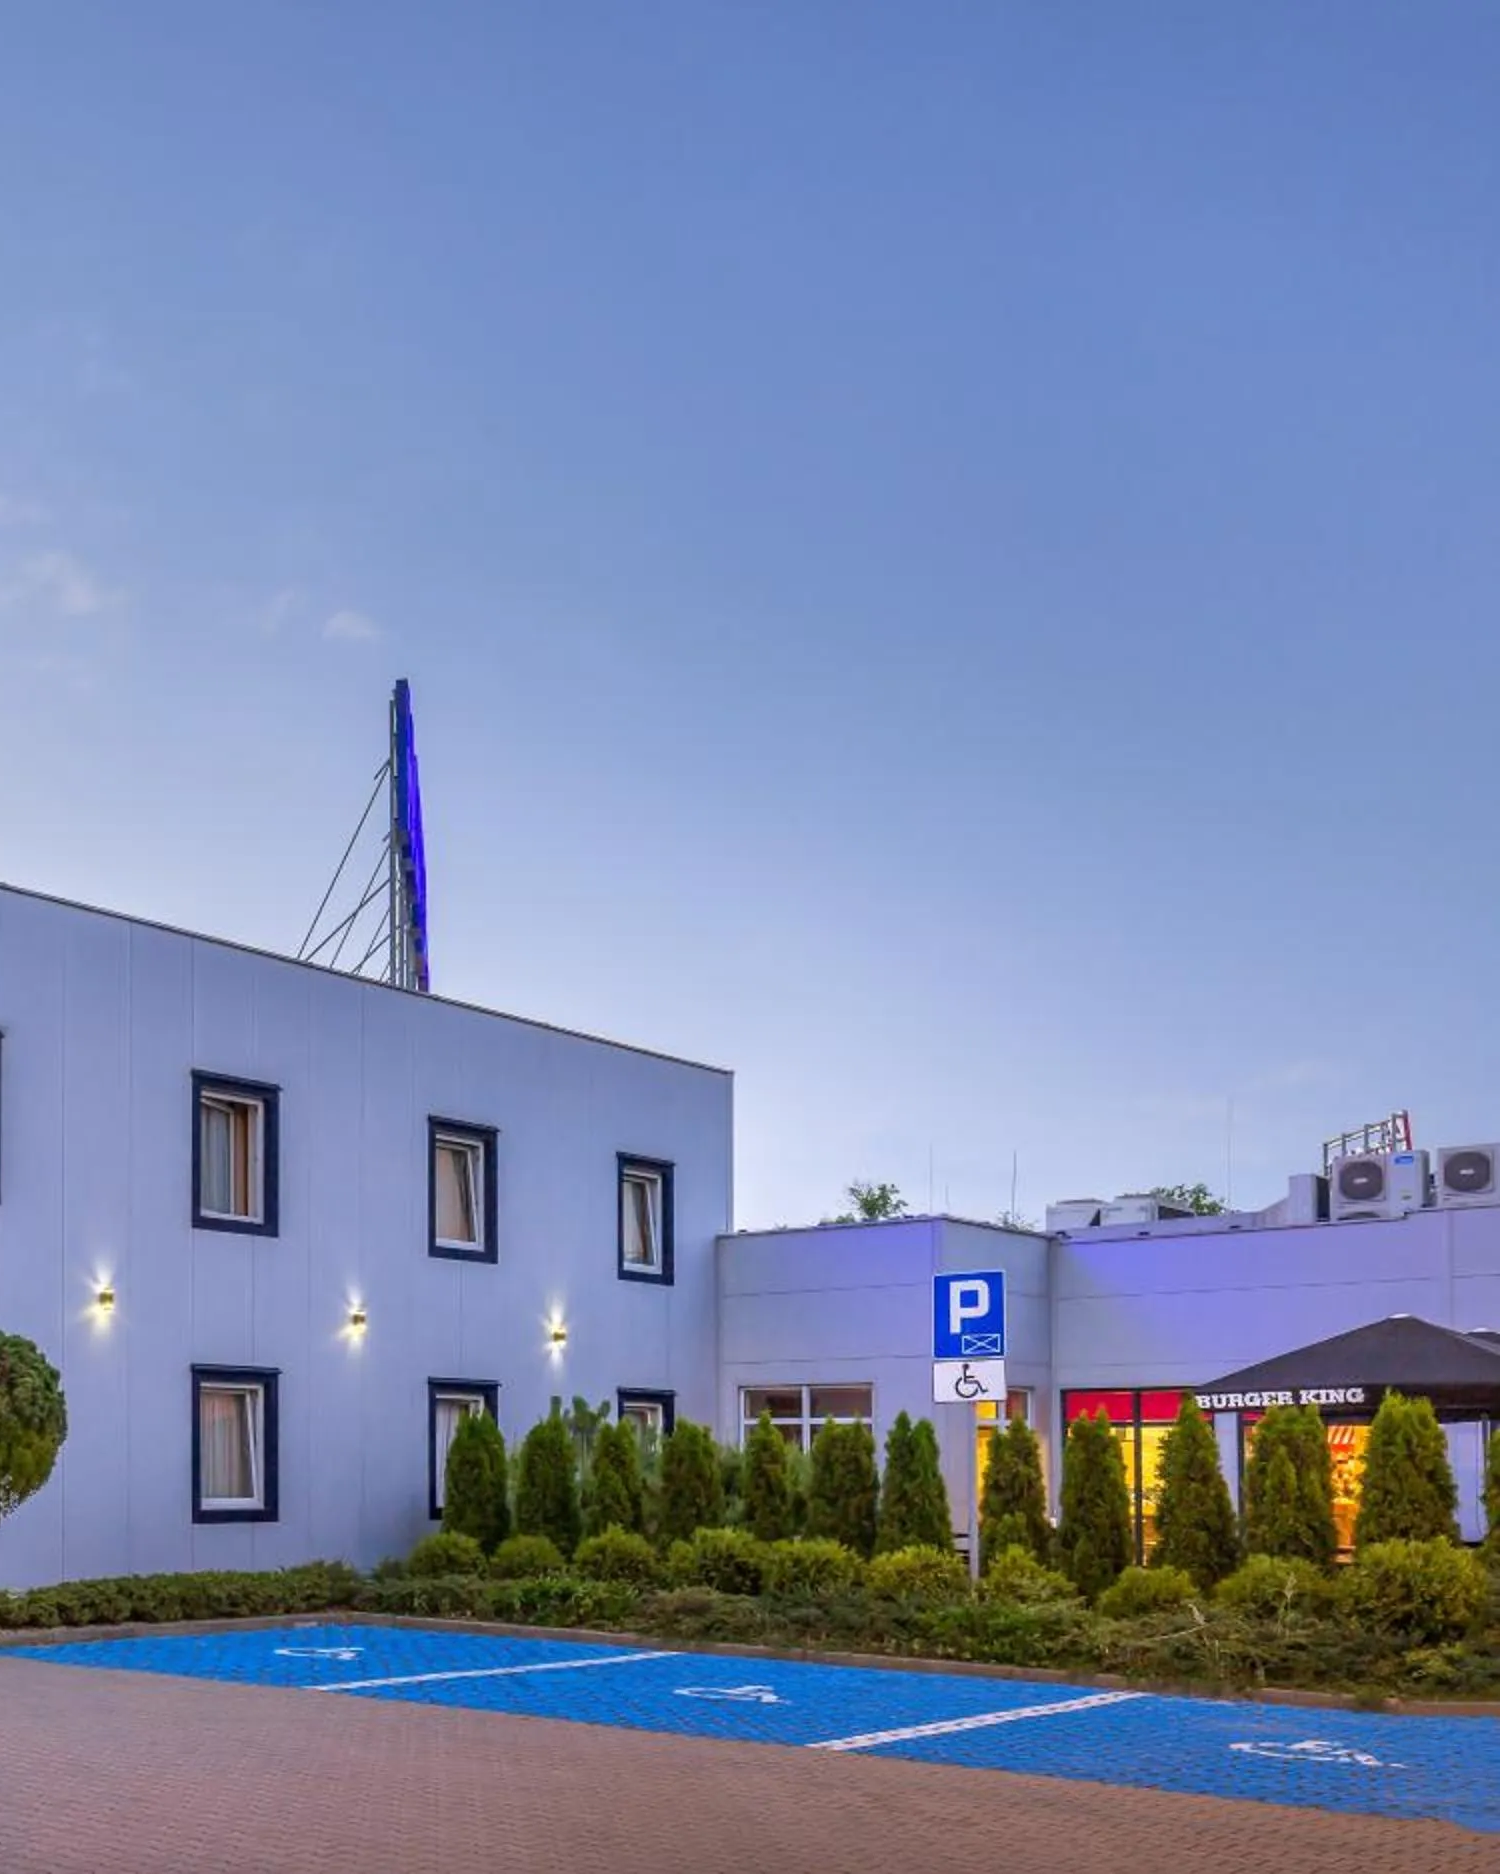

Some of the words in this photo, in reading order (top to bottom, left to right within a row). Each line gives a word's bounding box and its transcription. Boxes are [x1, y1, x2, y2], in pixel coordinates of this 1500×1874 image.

[948, 1278, 990, 1334] P
[1195, 1390, 1293, 1409] BURGER
[1299, 1387, 1365, 1405] KING
